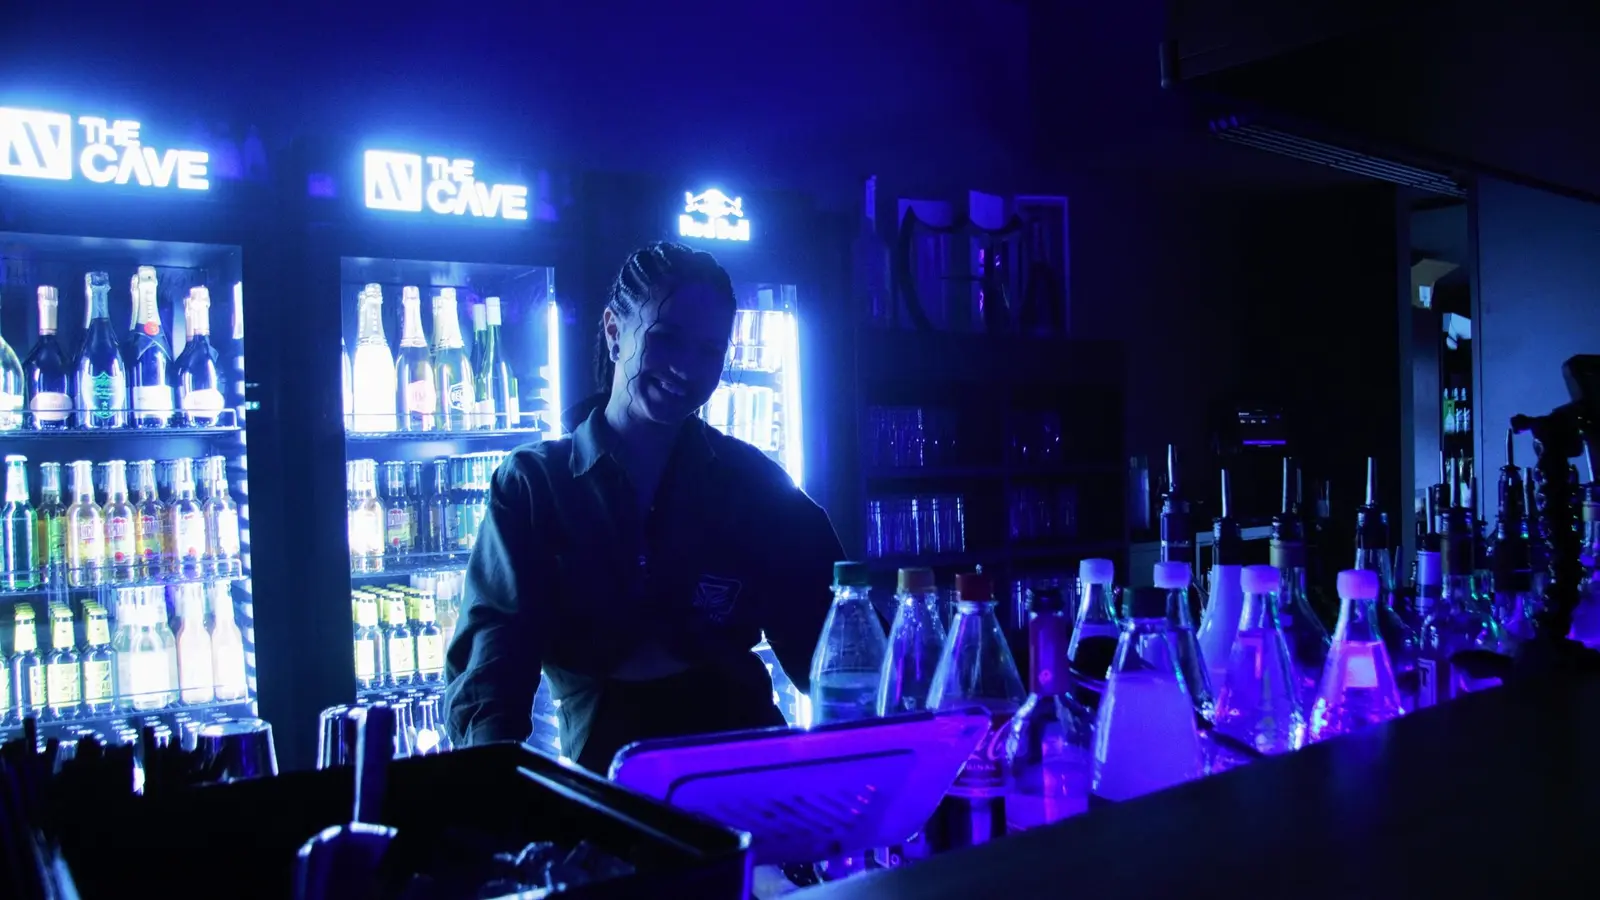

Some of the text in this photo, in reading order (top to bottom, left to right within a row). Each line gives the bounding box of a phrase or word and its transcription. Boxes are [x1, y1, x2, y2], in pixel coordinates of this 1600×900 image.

[78, 116, 141, 147] THE
[80, 144, 209, 190] CAVE
[426, 156, 475, 182] THE
[426, 180, 528, 220] CAVE
